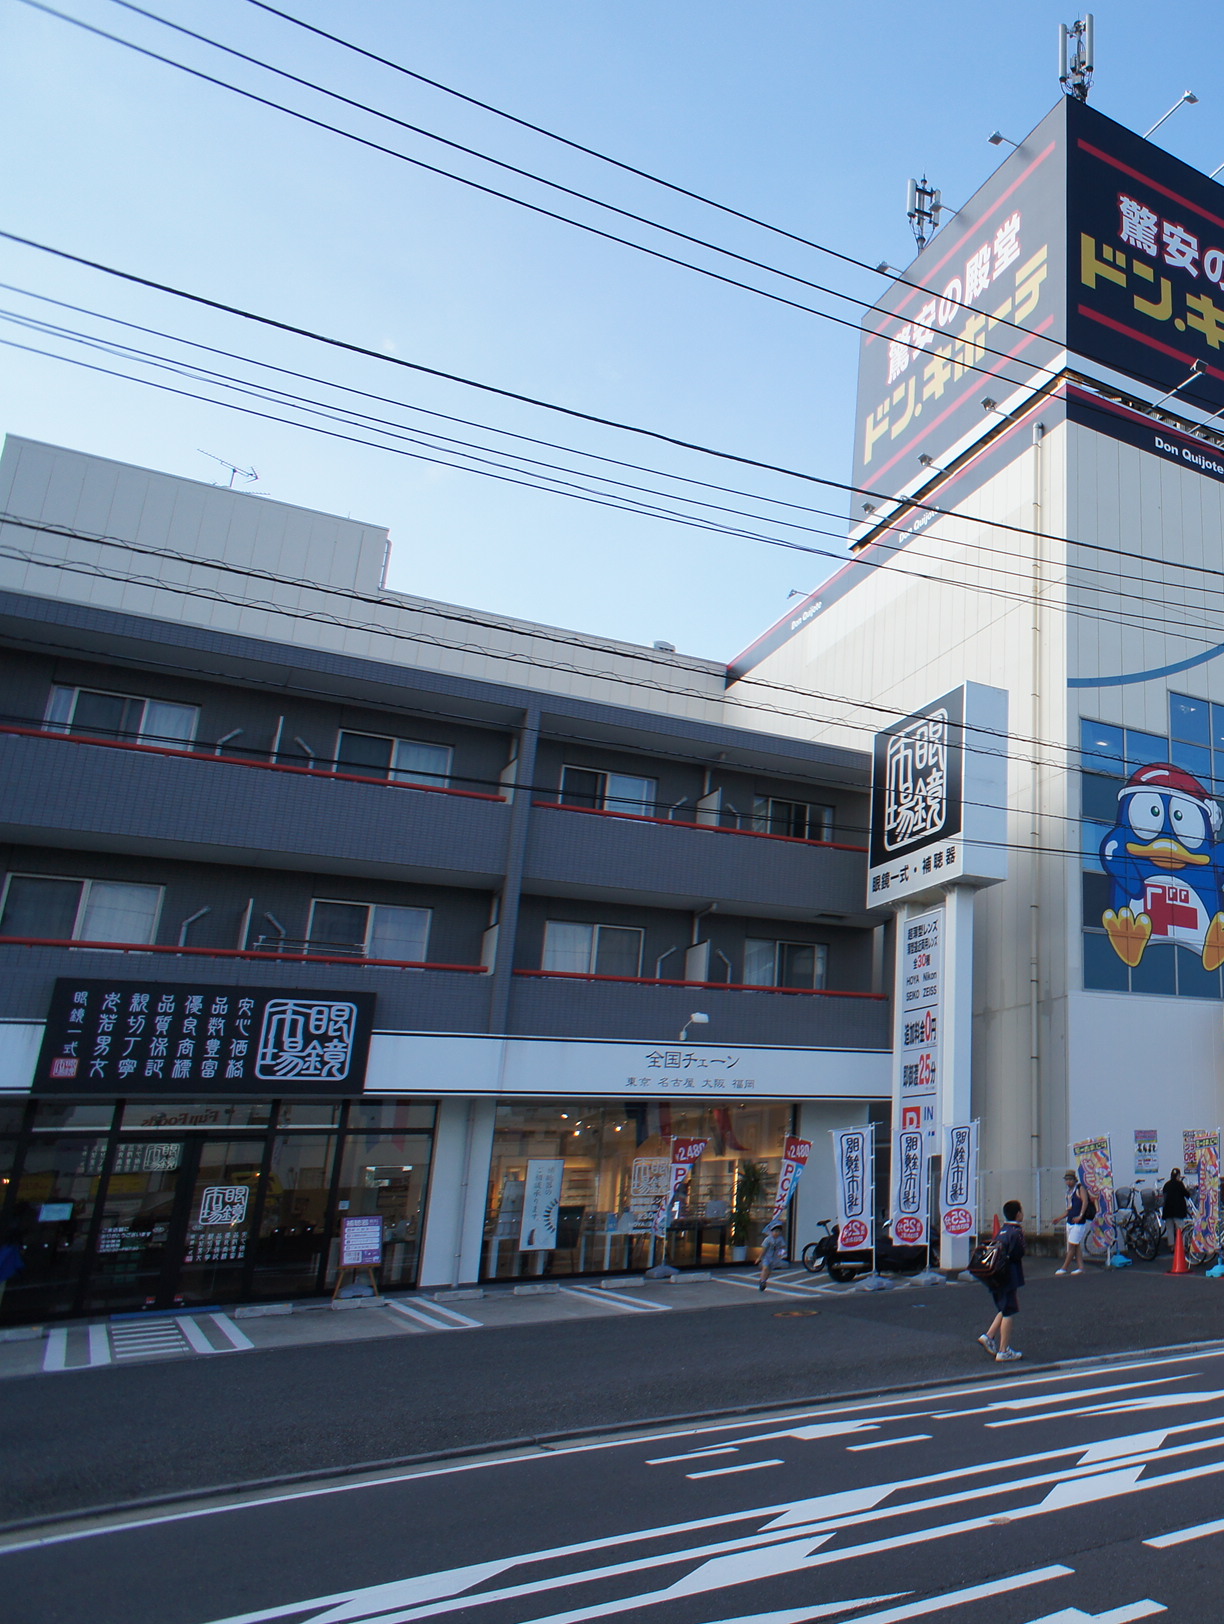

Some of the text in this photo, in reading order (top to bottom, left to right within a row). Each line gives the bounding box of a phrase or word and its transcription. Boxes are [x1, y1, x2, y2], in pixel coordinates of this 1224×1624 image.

[887, 211, 1021, 384] 驚安の殿堂
[1154, 436, 1224, 474] Don Quijote
[923, 971, 937, 982] Nikon
[923, 985, 937, 998] ZEISS
[259, 1002, 352, 1078] 眼鏡市場
[645, 1051, 740, 1069] 全国チェーン
[625, 1076, 755, 1089] 東京 名古屋 大阪 福岡
